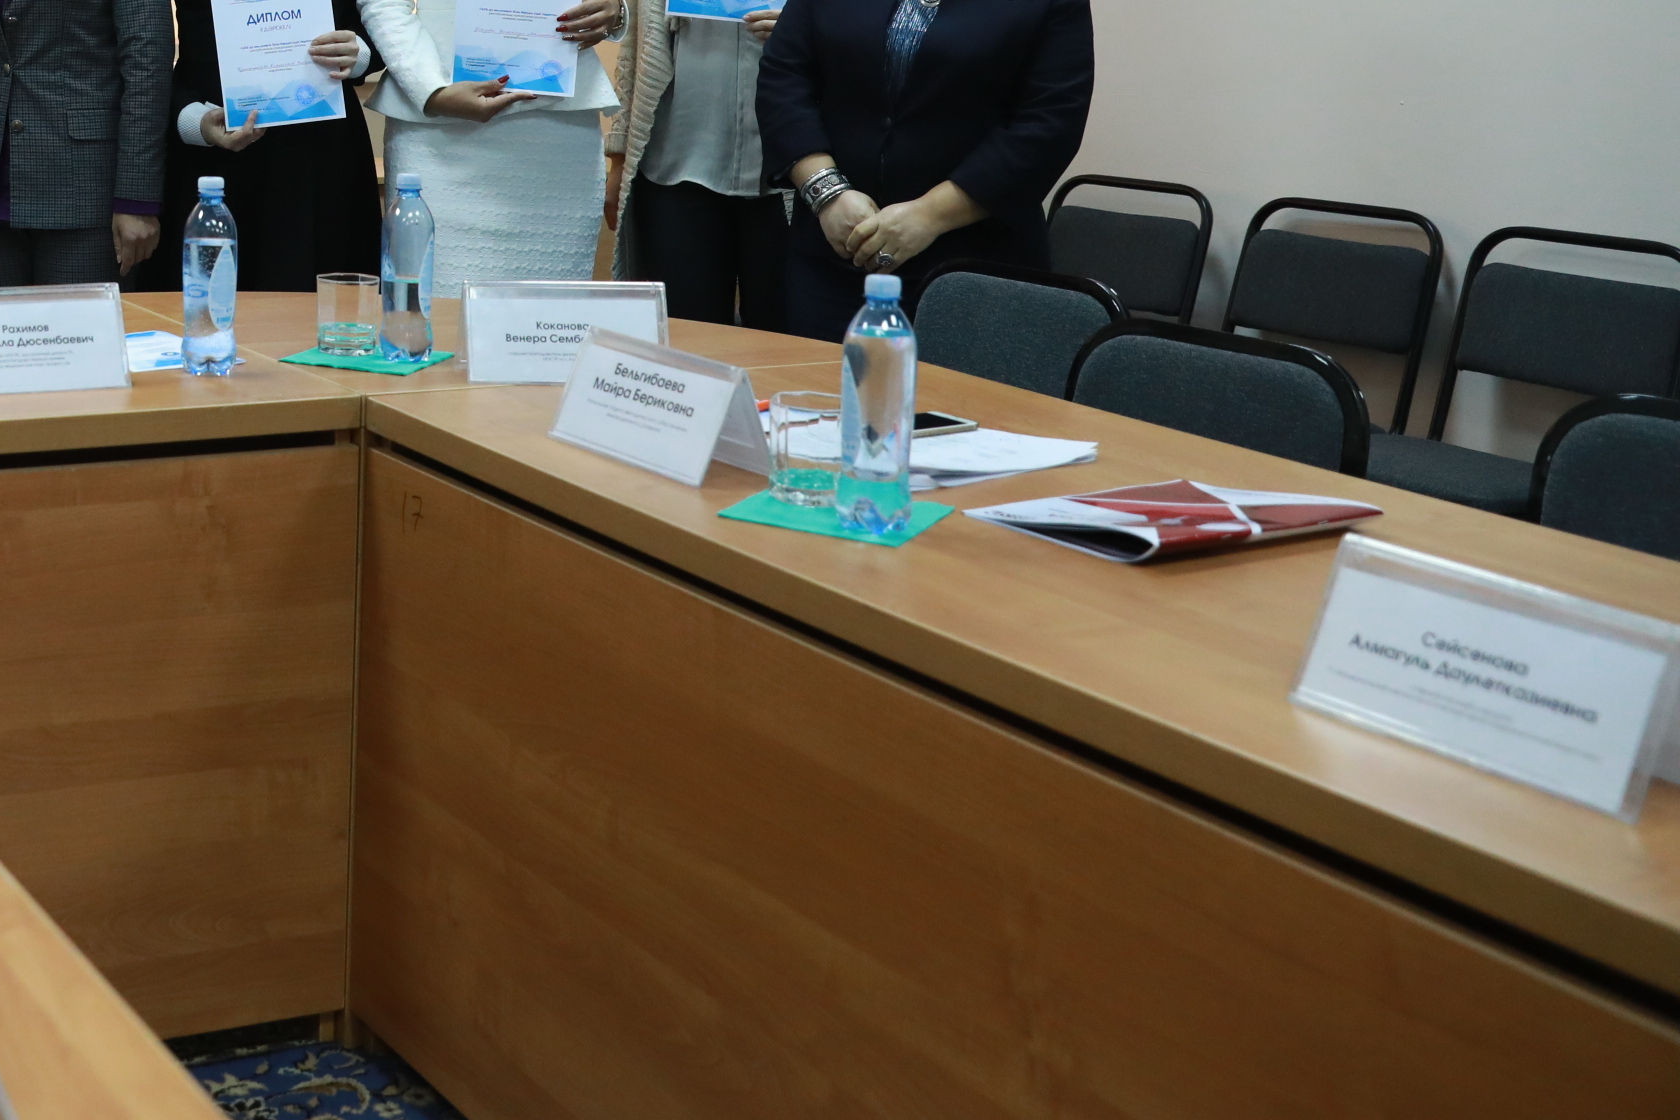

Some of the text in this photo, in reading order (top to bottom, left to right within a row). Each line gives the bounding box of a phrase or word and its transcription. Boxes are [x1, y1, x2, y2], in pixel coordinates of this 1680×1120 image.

[246, 8, 302, 26] ДИПЛОМ
[1, 323, 50, 334] Рахимов
[535, 321, 590, 331] Коканова
[17, 335, 95, 348] Дюсенбаевич
[505, 333, 547, 344] Венера
[614, 362, 686, 394] Бельгибаева
[593, 376, 632, 399] Майра
[632, 388, 695, 418] Бериковна
[1348, 633, 1431, 671] Алмагуль
